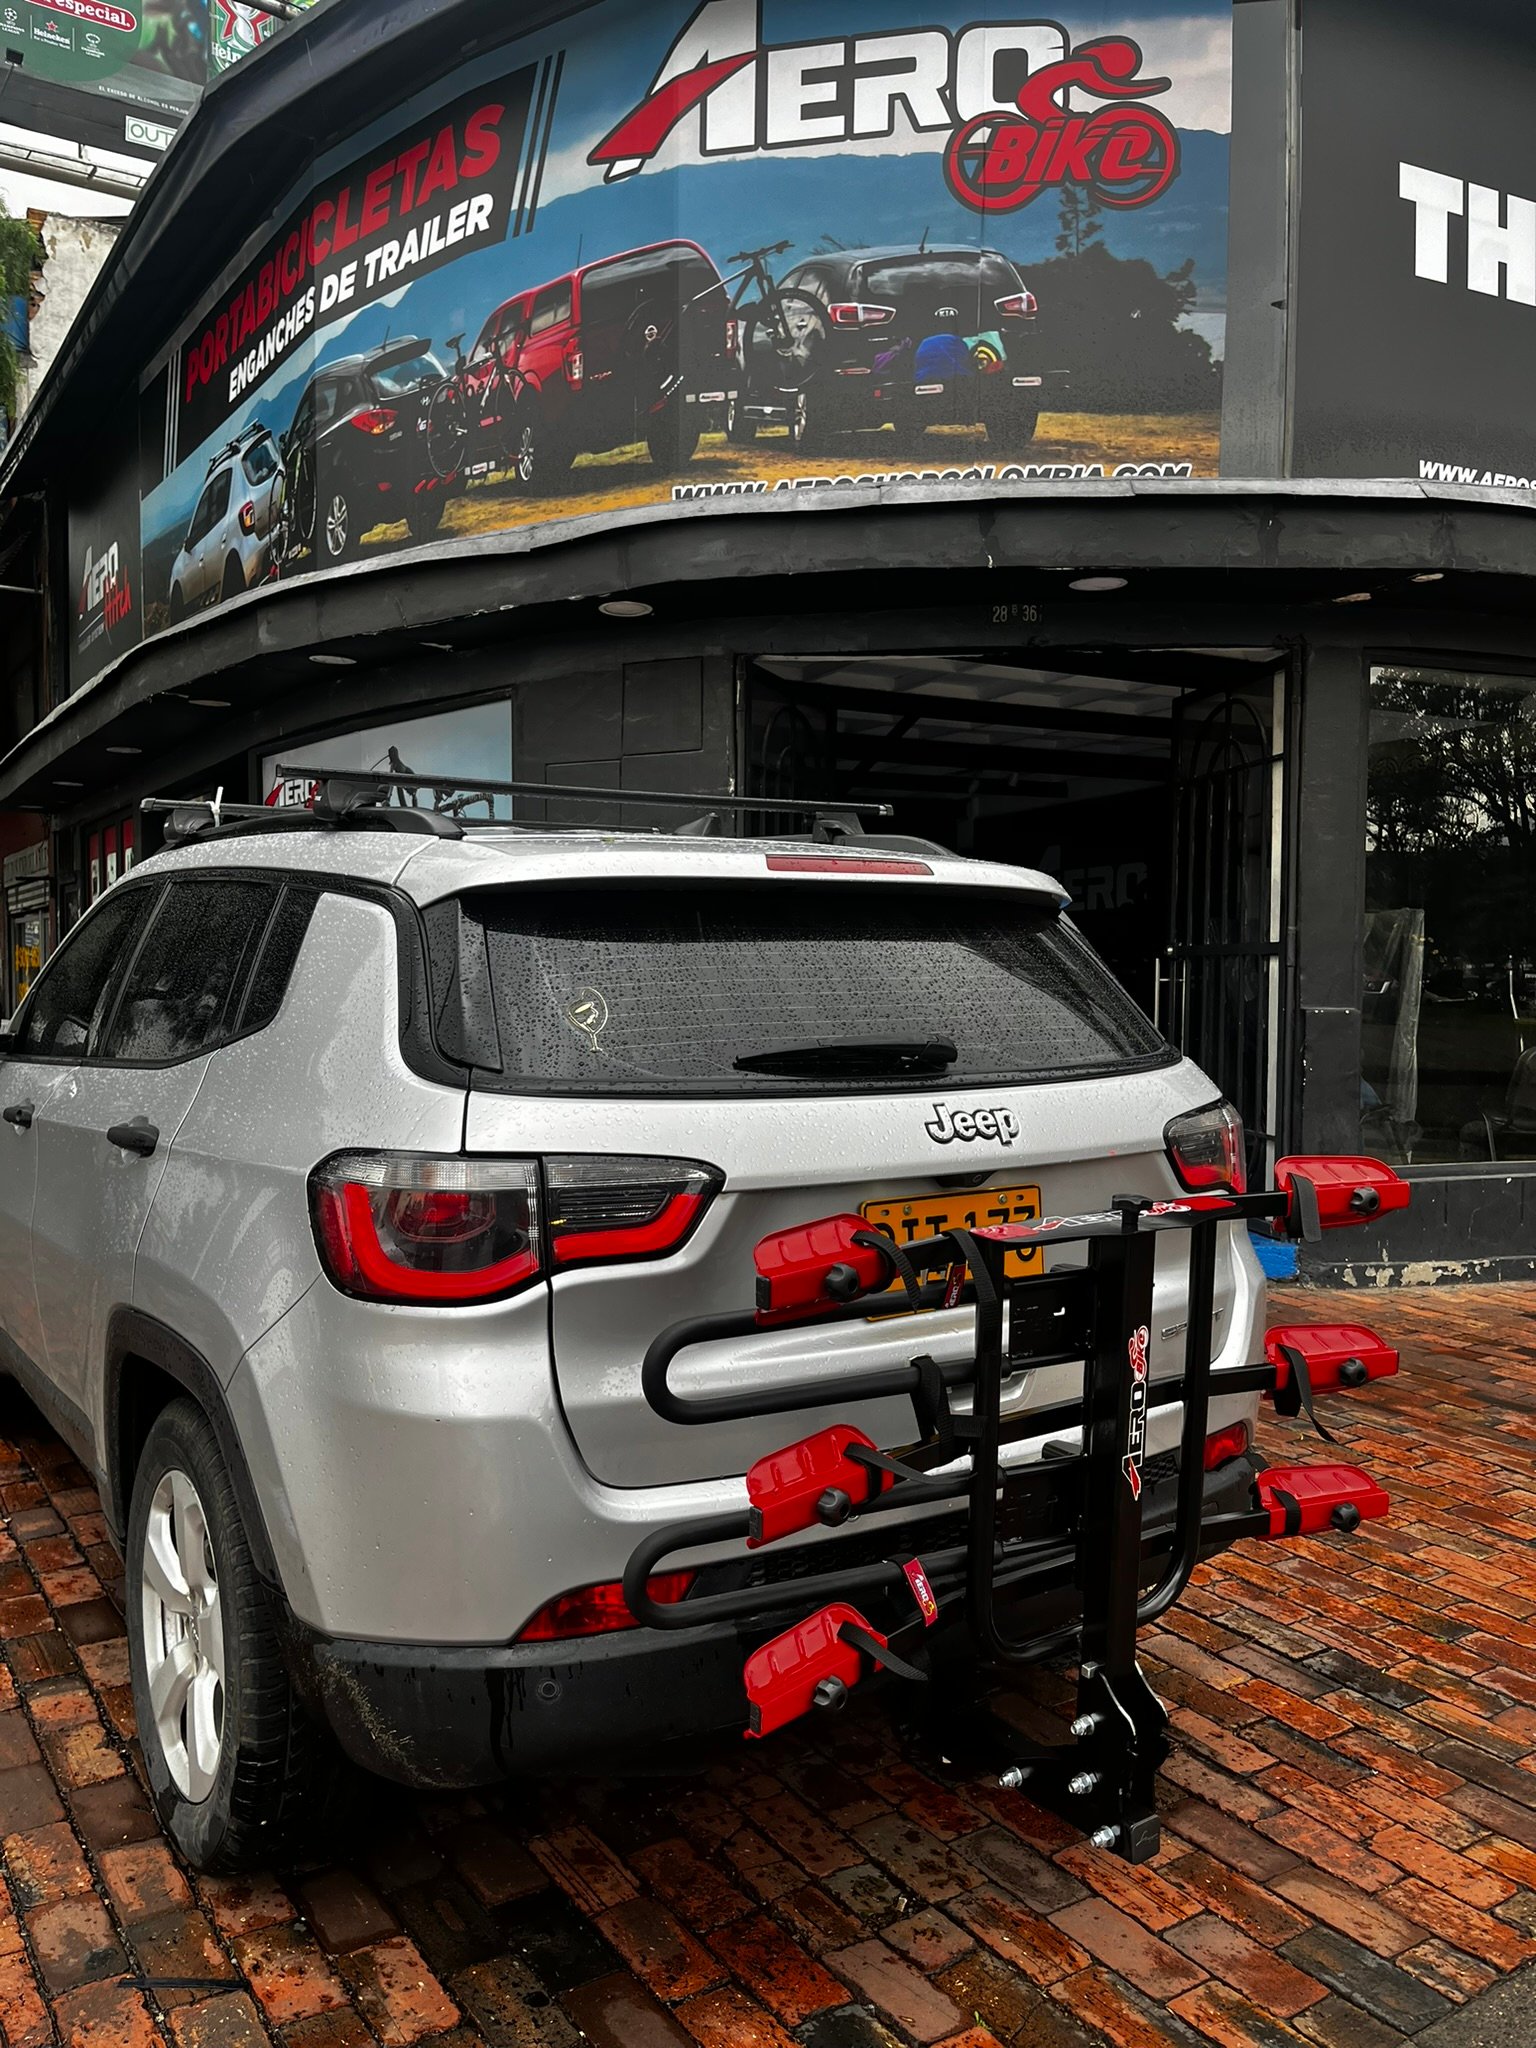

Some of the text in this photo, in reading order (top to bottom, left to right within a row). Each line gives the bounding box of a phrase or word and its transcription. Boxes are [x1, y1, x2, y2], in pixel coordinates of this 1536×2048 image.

[33, 27, 71, 44] Heineken
[588, 0, 1066, 183] AERO
[186, 103, 506, 404] PORTABICICLETAS
[228, 192, 494, 404] ENGANCHES DE TRAILER
[1399, 161, 1536, 307] TH
[992, 605, 1008, 623] 28
[1022, 604, 1037, 622] 36
[924, 1102, 1020, 1147] Jeep
[1121, 1380, 1147, 1501] AERO
